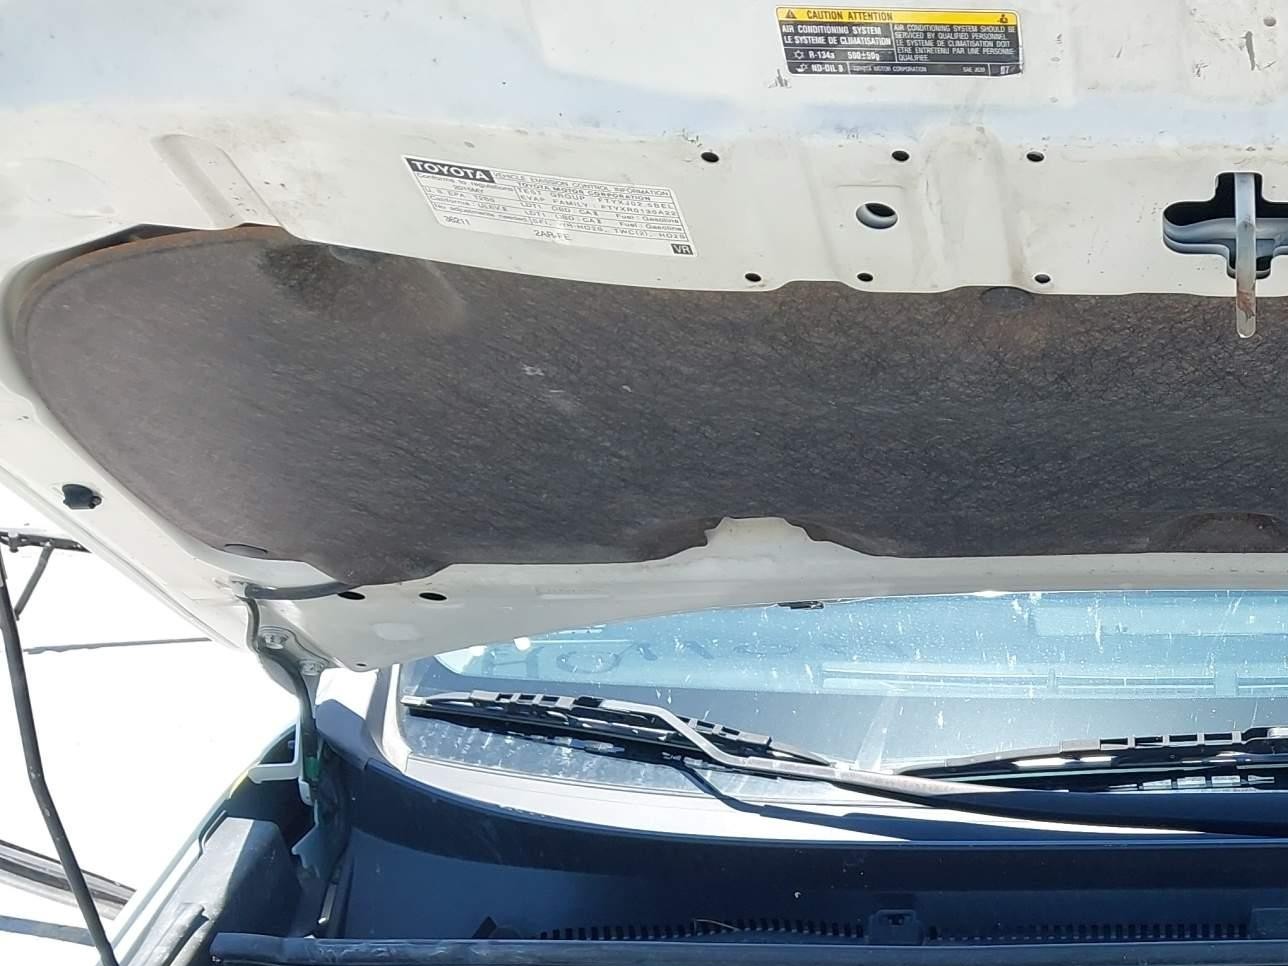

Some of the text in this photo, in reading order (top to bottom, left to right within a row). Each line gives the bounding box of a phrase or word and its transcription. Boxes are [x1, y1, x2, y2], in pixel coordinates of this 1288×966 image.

[806, 10, 893, 21] CAUTION ATTENTION
[782, 25, 882, 35] AIR CONDITIONING SYSTEM
[784, 35, 793, 43] LE
[795, 36, 826, 44] SYSTEME
[840, 37, 891, 46] CLIMATISATION
[809, 51, 836, 59] R-134a
[411, 160, 490, 181] TOYOTA
[673, 244, 691, 254] VR
